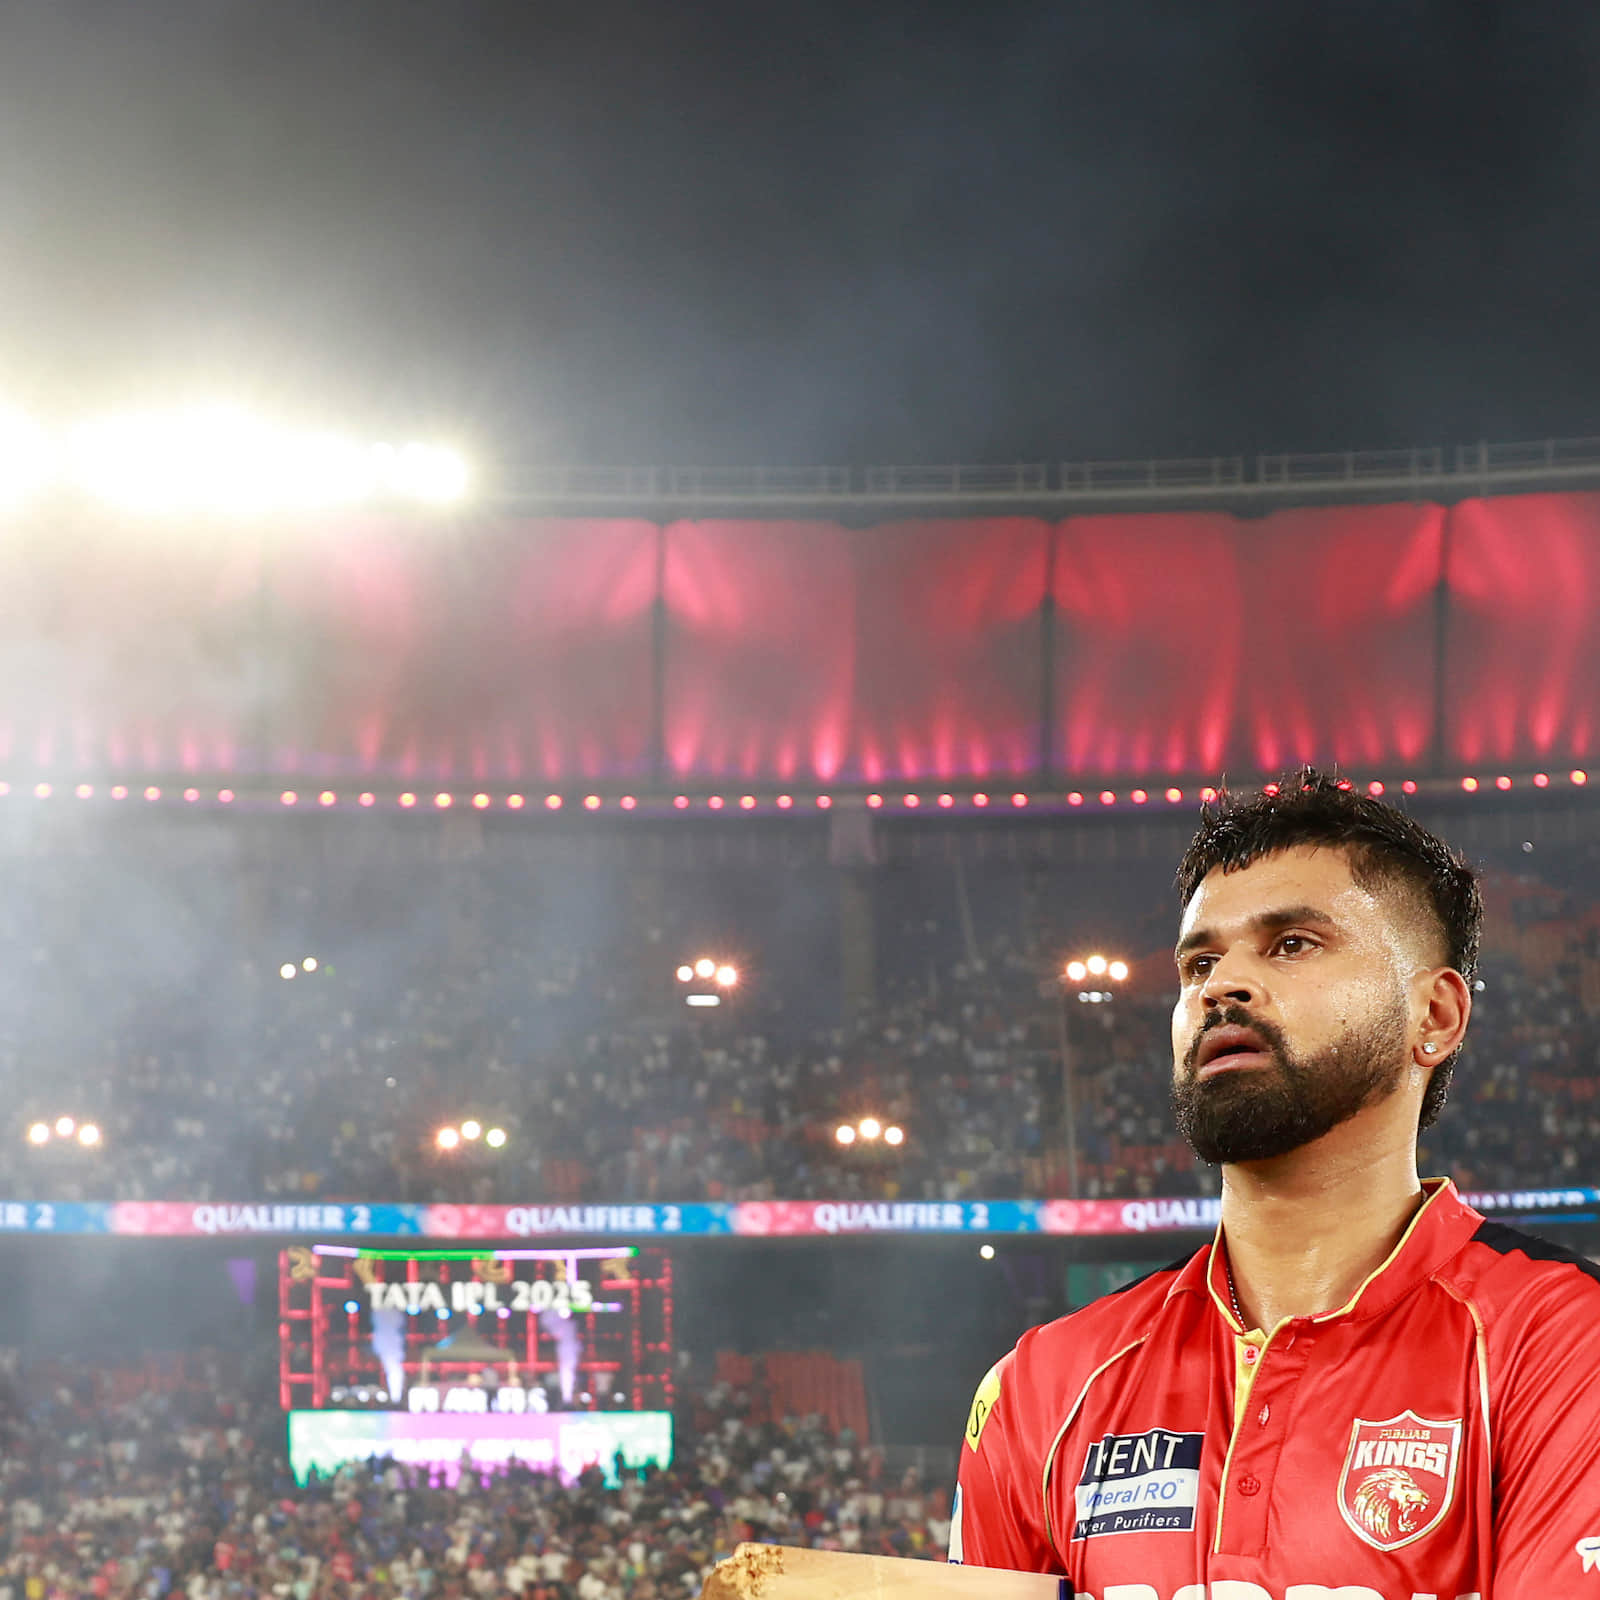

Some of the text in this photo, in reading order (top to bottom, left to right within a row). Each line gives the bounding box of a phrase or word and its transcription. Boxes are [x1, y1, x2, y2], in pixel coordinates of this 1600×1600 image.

[33, 1203, 56, 1229] 2
[192, 1205, 372, 1234] QUALIFIER 2
[505, 1204, 683, 1236] QUALIFIER 2
[812, 1202, 990, 1233] QUALIFIER 2
[1121, 1200, 1221, 1231] QUALI
[365, 1279, 593, 1311] TATA IPL 2025
[1352, 1440, 1449, 1478] KINGS
[1079, 1513, 1181, 1535] Wer Purifiers
